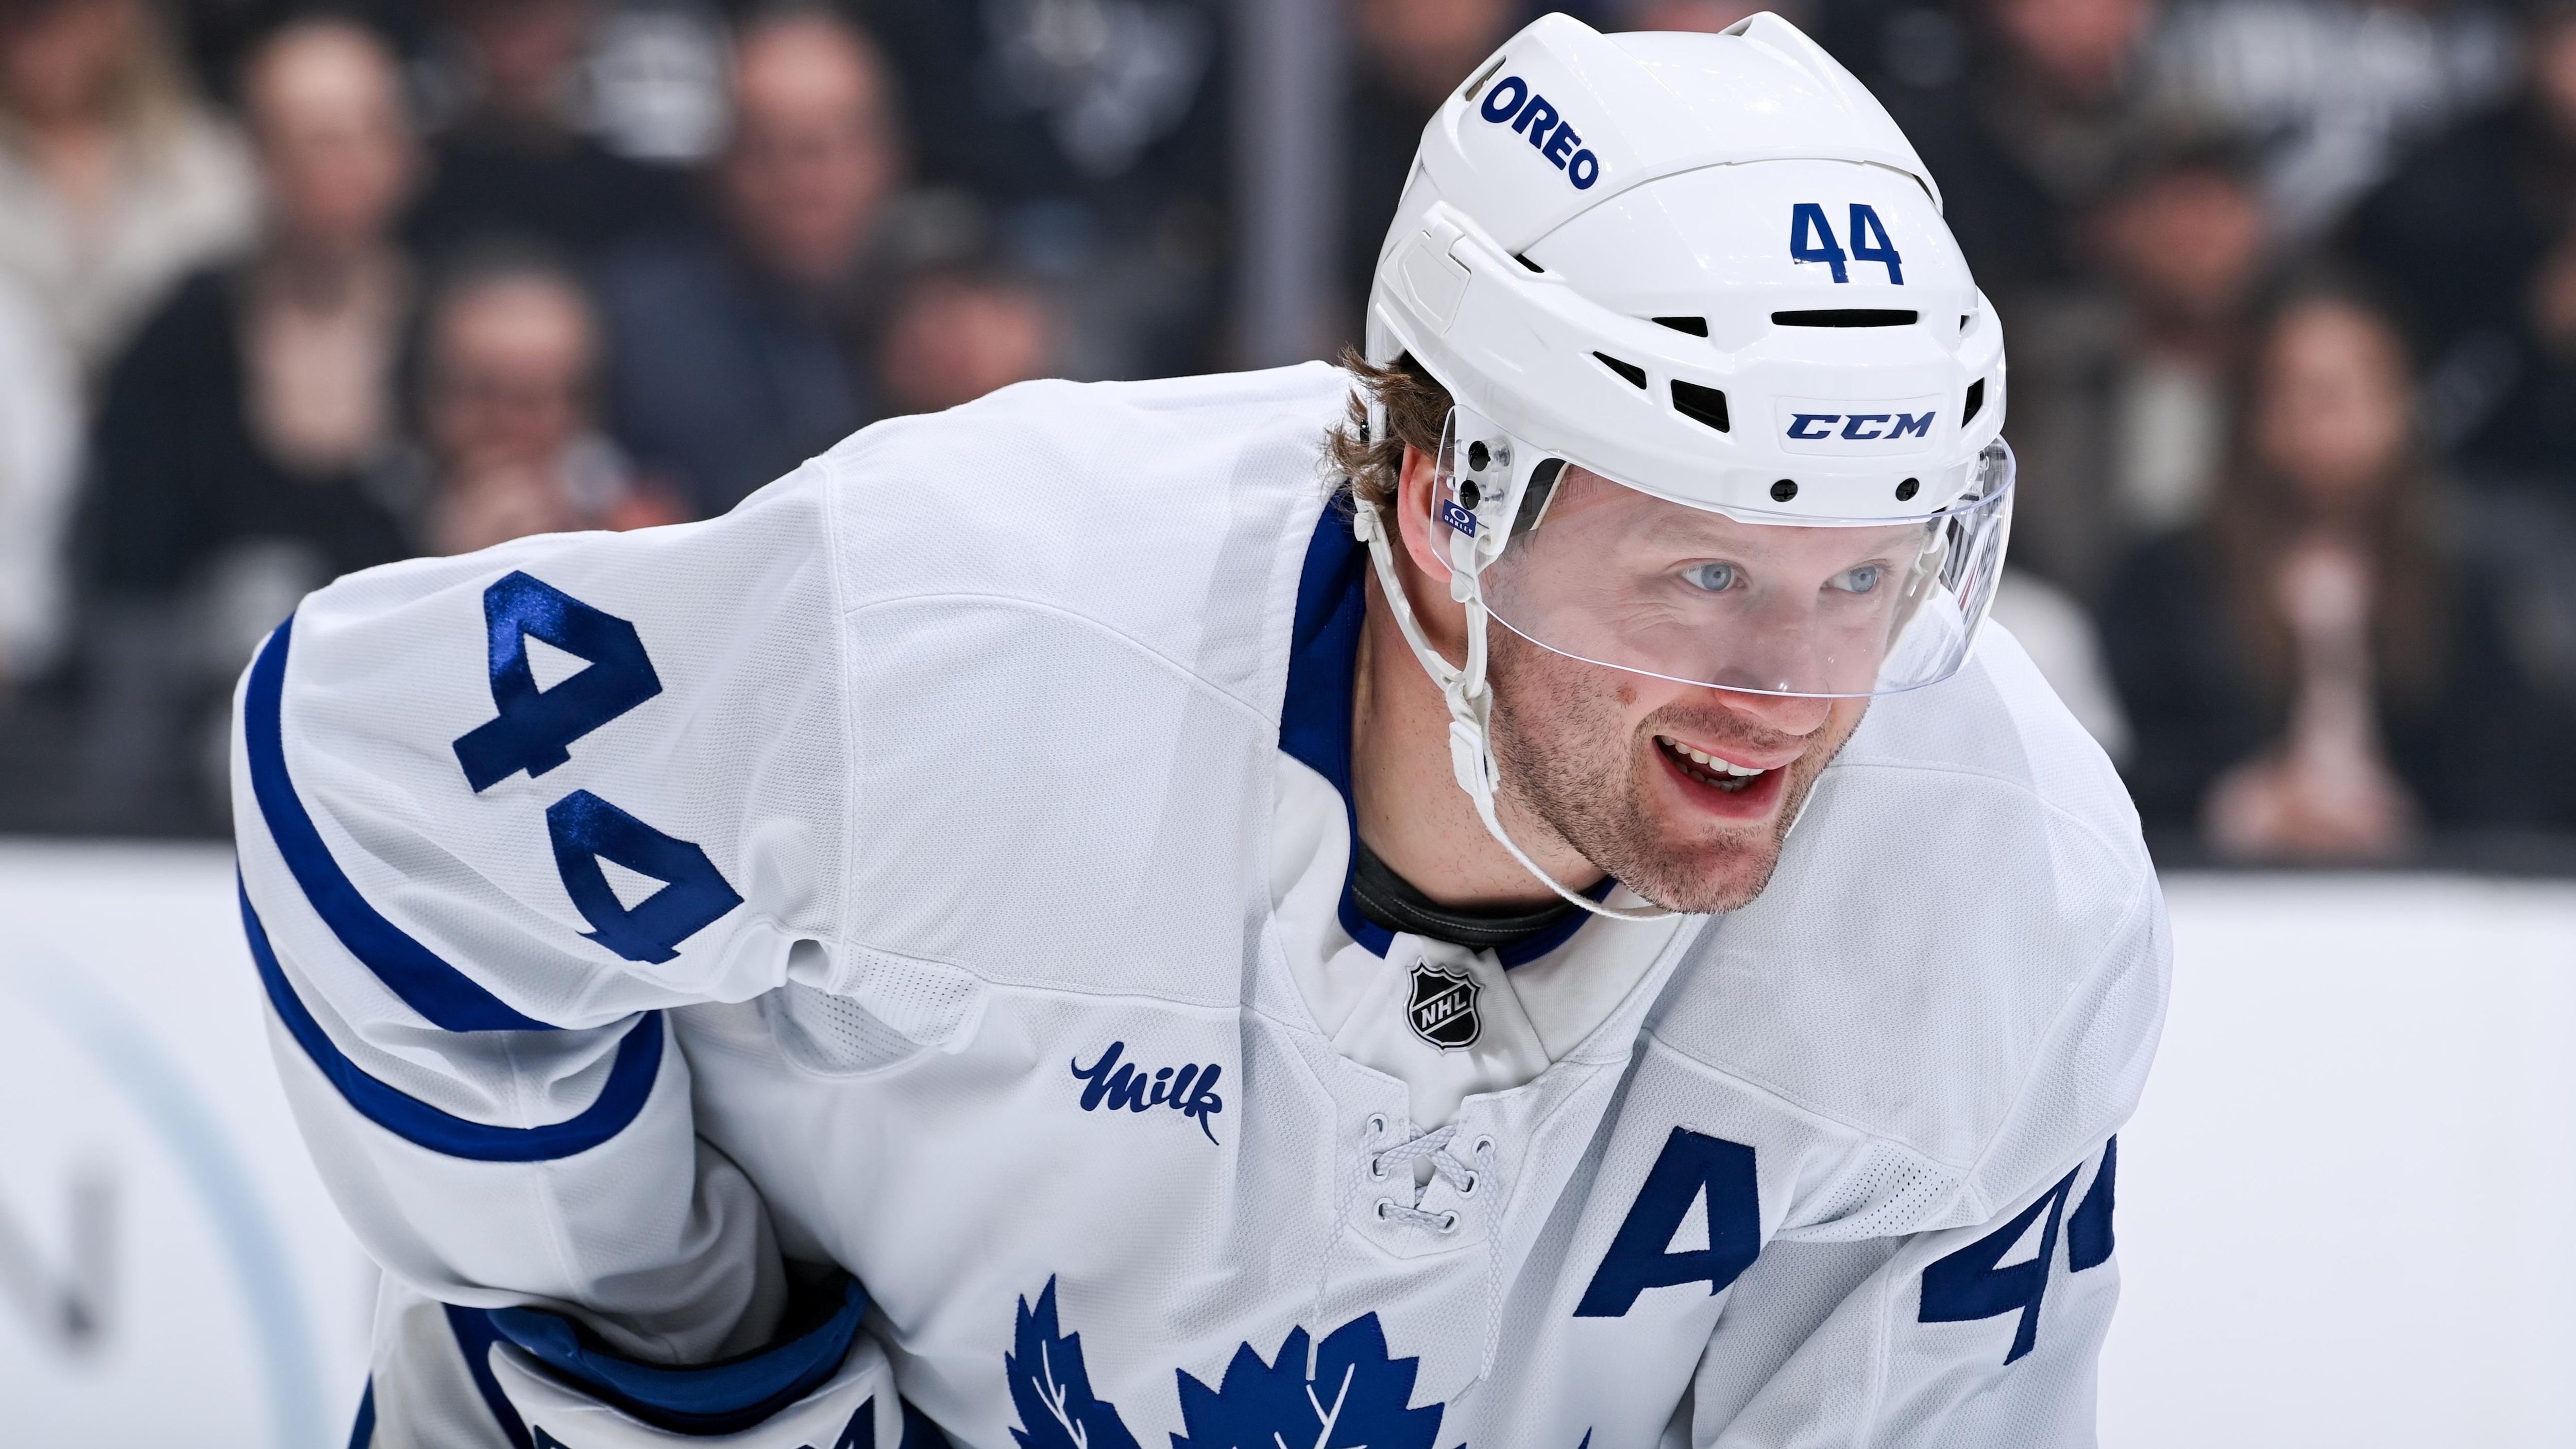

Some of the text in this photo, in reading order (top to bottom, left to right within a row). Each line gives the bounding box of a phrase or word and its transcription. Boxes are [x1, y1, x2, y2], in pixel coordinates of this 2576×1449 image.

[1481, 76, 1599, 190] OREO
[1790, 203, 1904, 285] 44
[1786, 411, 1937, 440] CCM
[1445, 515, 1472, 534] OAKLEY
[452, 570, 745, 965] 44
[1420, 991, 1467, 1029] NHL
[1071, 1041, 1223, 1146] Milk
[1572, 1125, 1761, 1317] A
